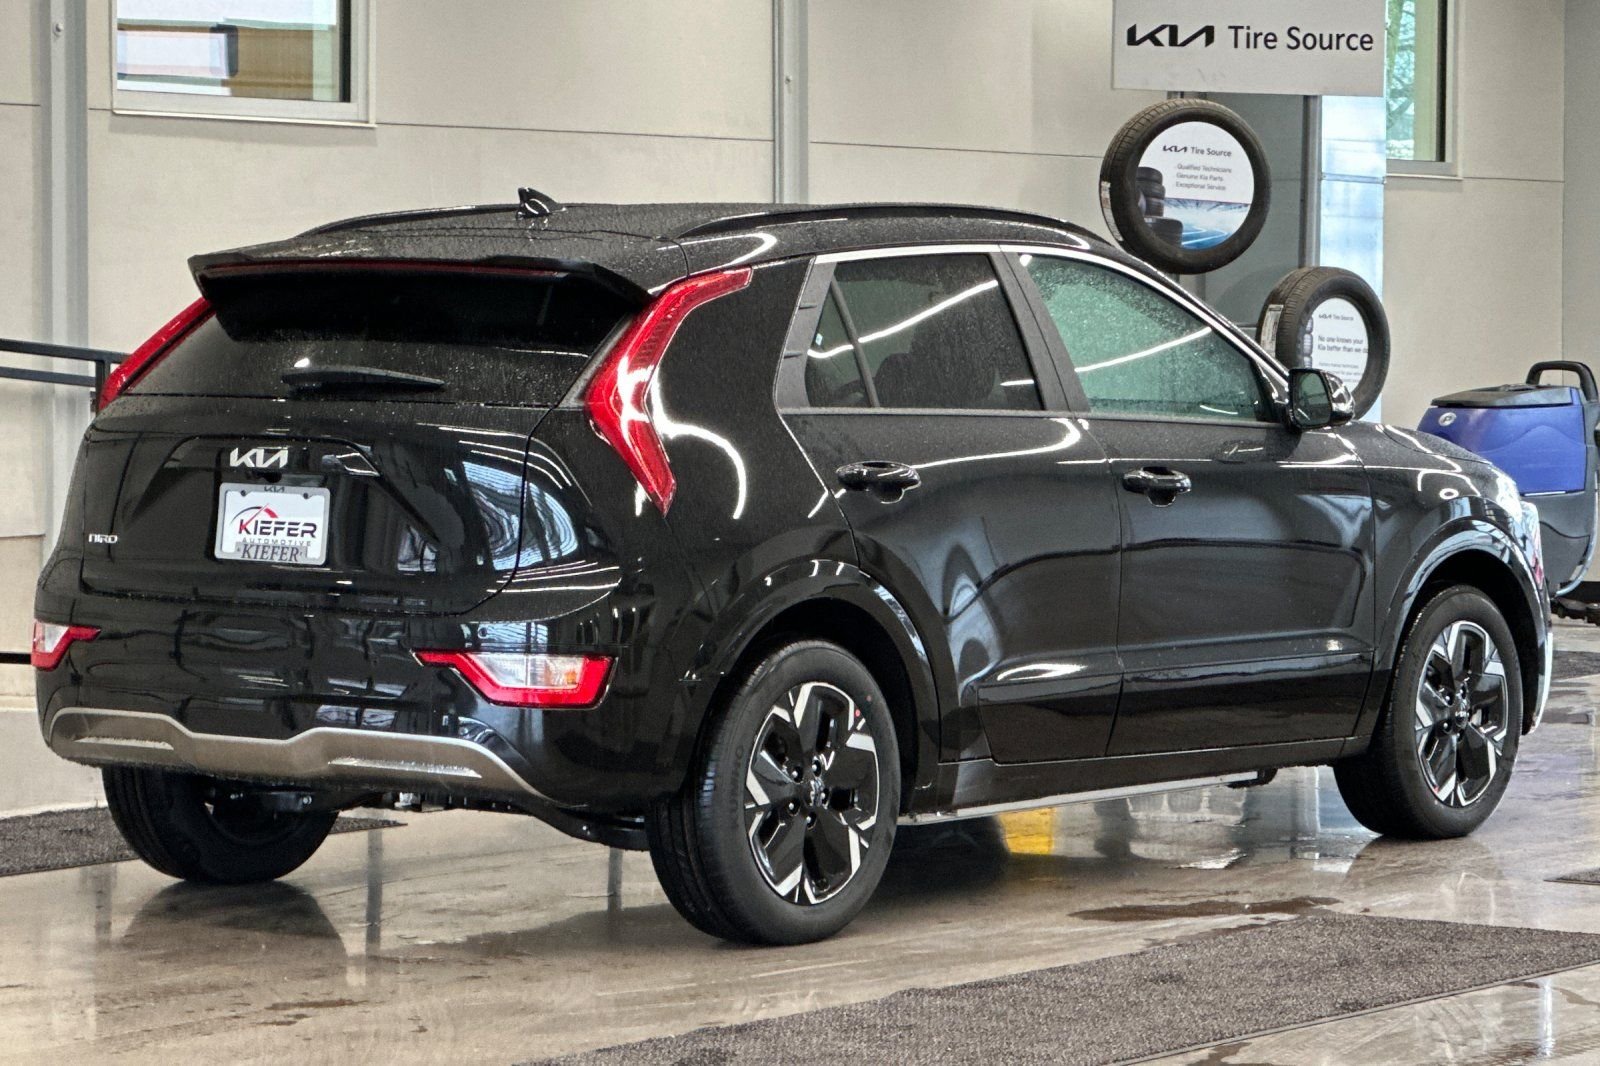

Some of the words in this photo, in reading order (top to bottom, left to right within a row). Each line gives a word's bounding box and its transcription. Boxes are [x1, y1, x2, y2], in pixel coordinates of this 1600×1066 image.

[1127, 24, 1215, 47] KIA
[1228, 25, 1278, 49] Tire
[1286, 26, 1374, 51] Source
[1162, 145, 1187, 153] KIA
[1191, 146, 1205, 155] Tire
[1206, 148, 1232, 157] Source
[1177, 163, 1201, 171] Qualified
[1176, 172, 1198, 180] Genuine
[1176, 181, 1205, 189] Exceptional
[229, 447, 289, 468] KIA
[264, 485, 285, 493] KIA
[238, 514, 317, 538] KIEFER
[242, 537, 311, 547] AUTOMOTIVE
[241, 543, 300, 562] KIEFER
